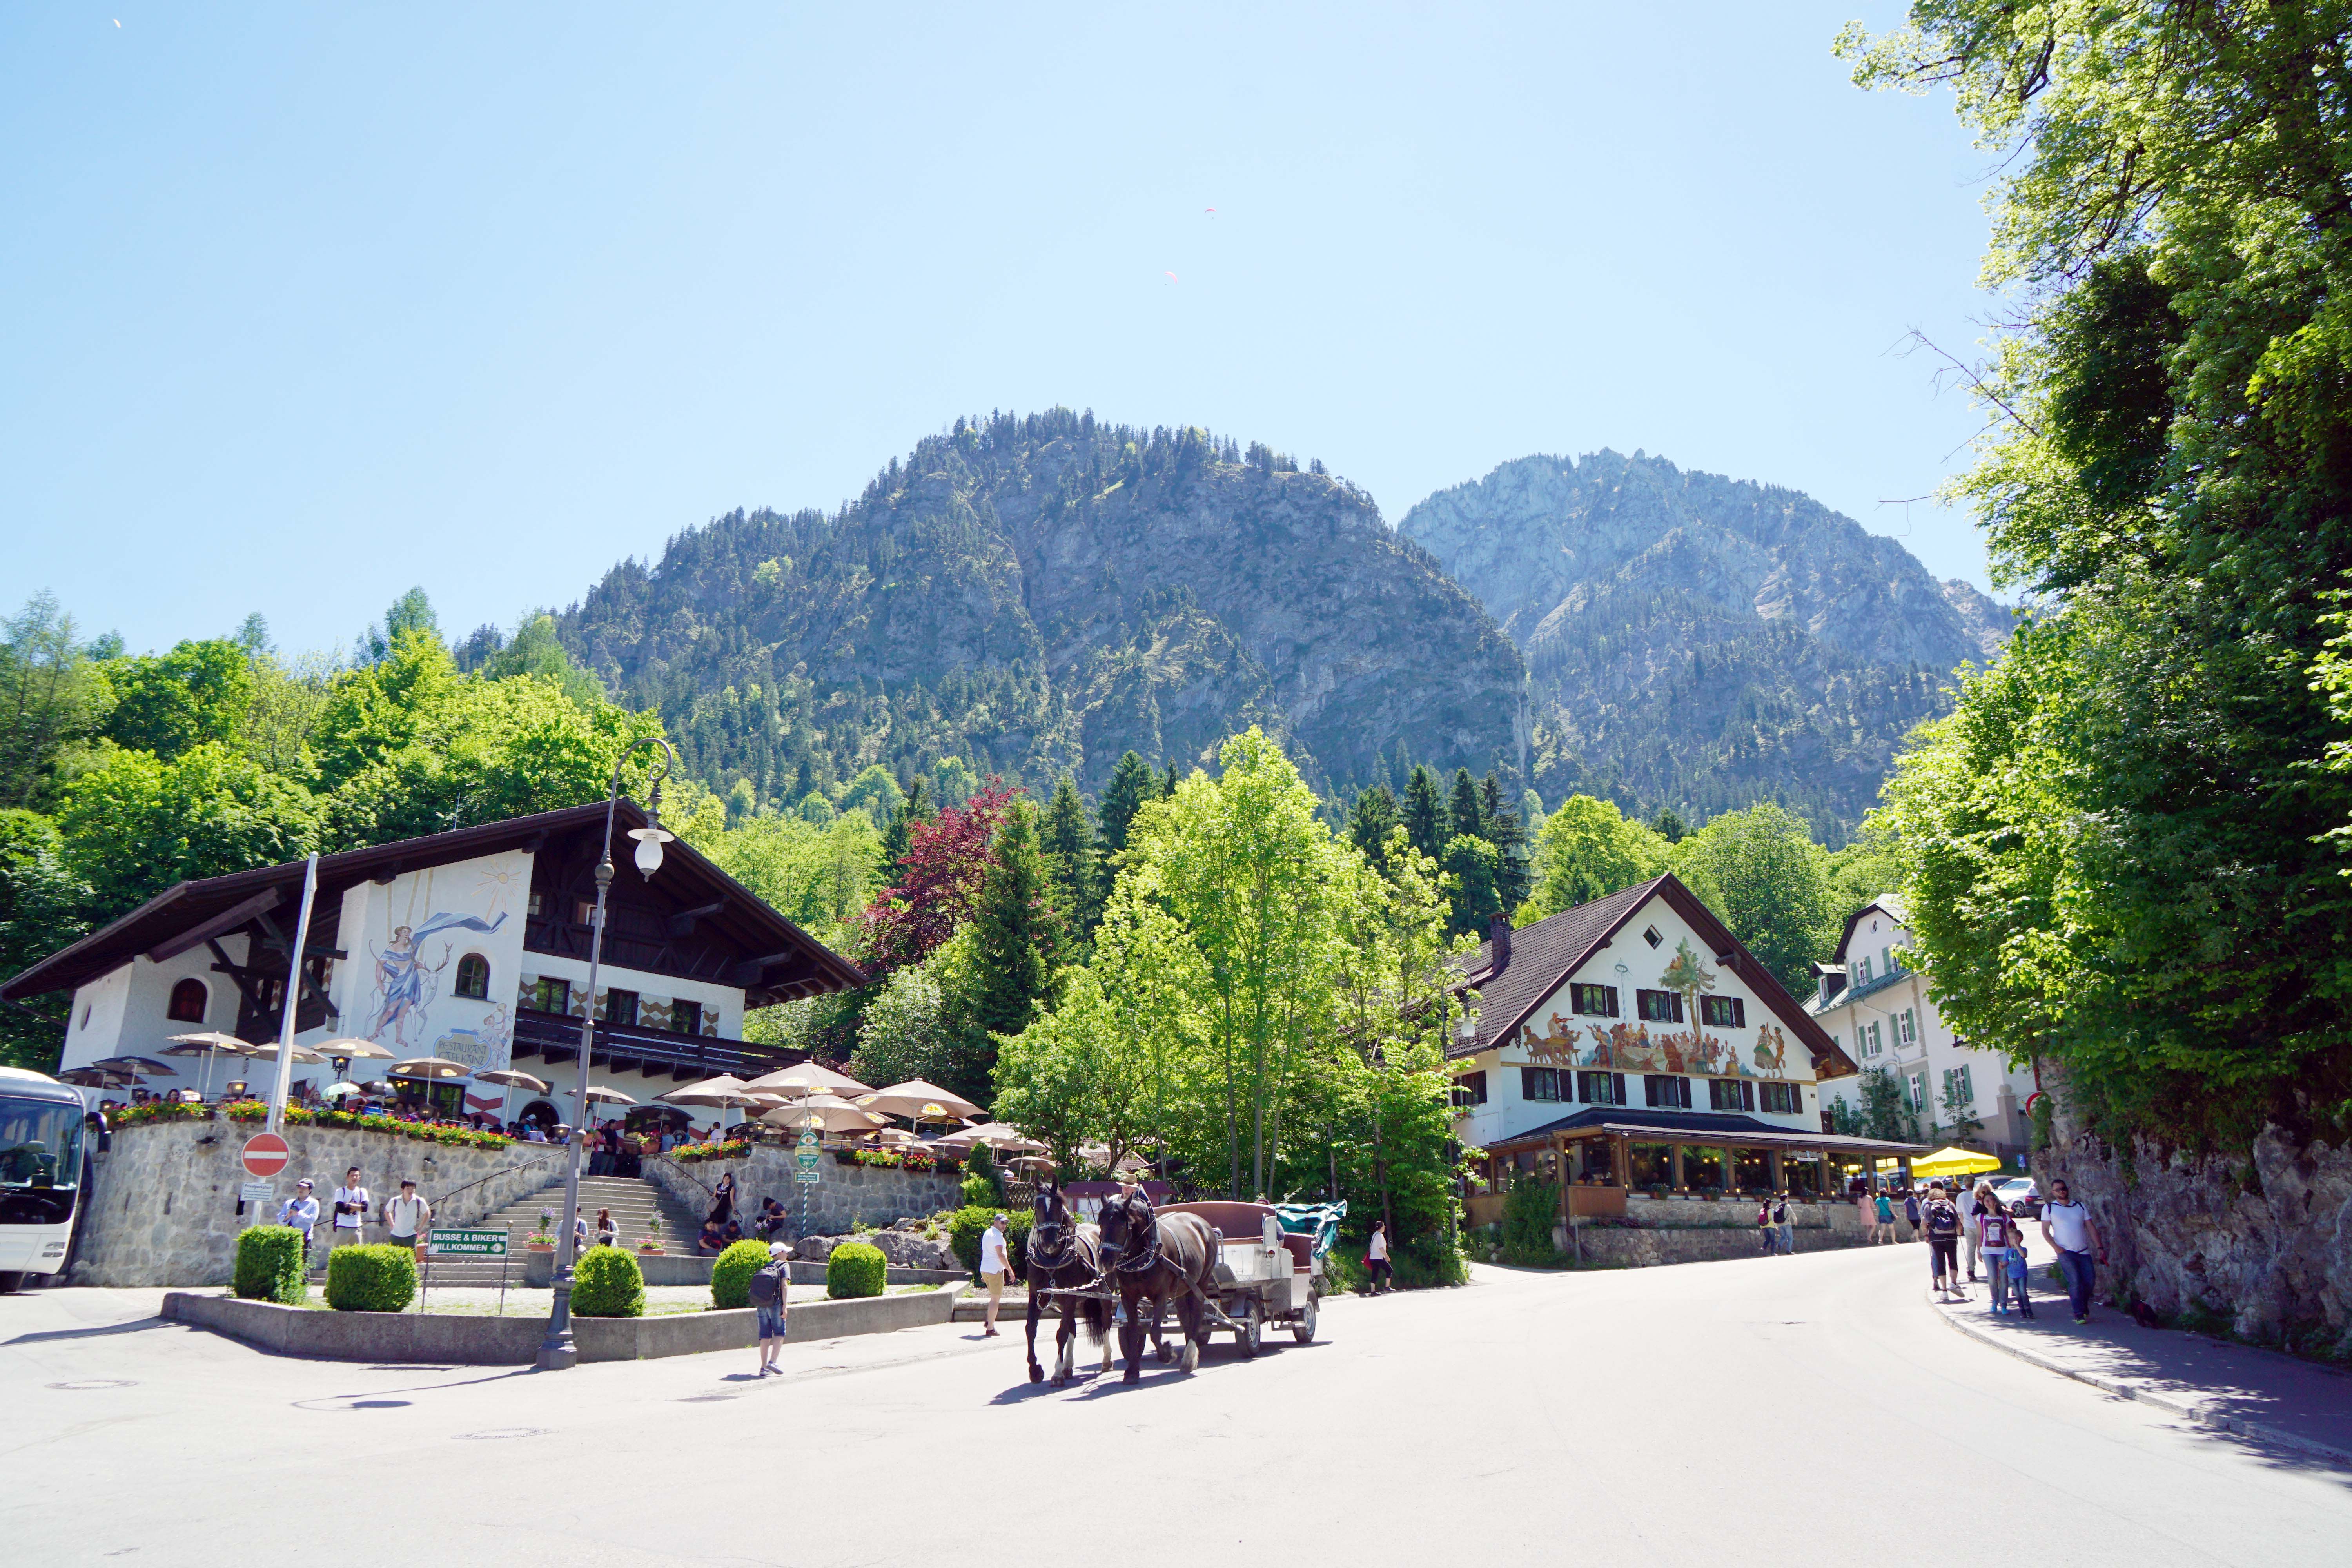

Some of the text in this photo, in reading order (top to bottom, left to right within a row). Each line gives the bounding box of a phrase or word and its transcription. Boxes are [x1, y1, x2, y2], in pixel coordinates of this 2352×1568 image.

[438, 1040, 488, 1055] RESTAURANT
[462, 1054, 484, 1065] KAINZ
[433, 1233, 462, 1241] BUSSE
[432, 1243, 488, 1251] WILLKOMMEN
